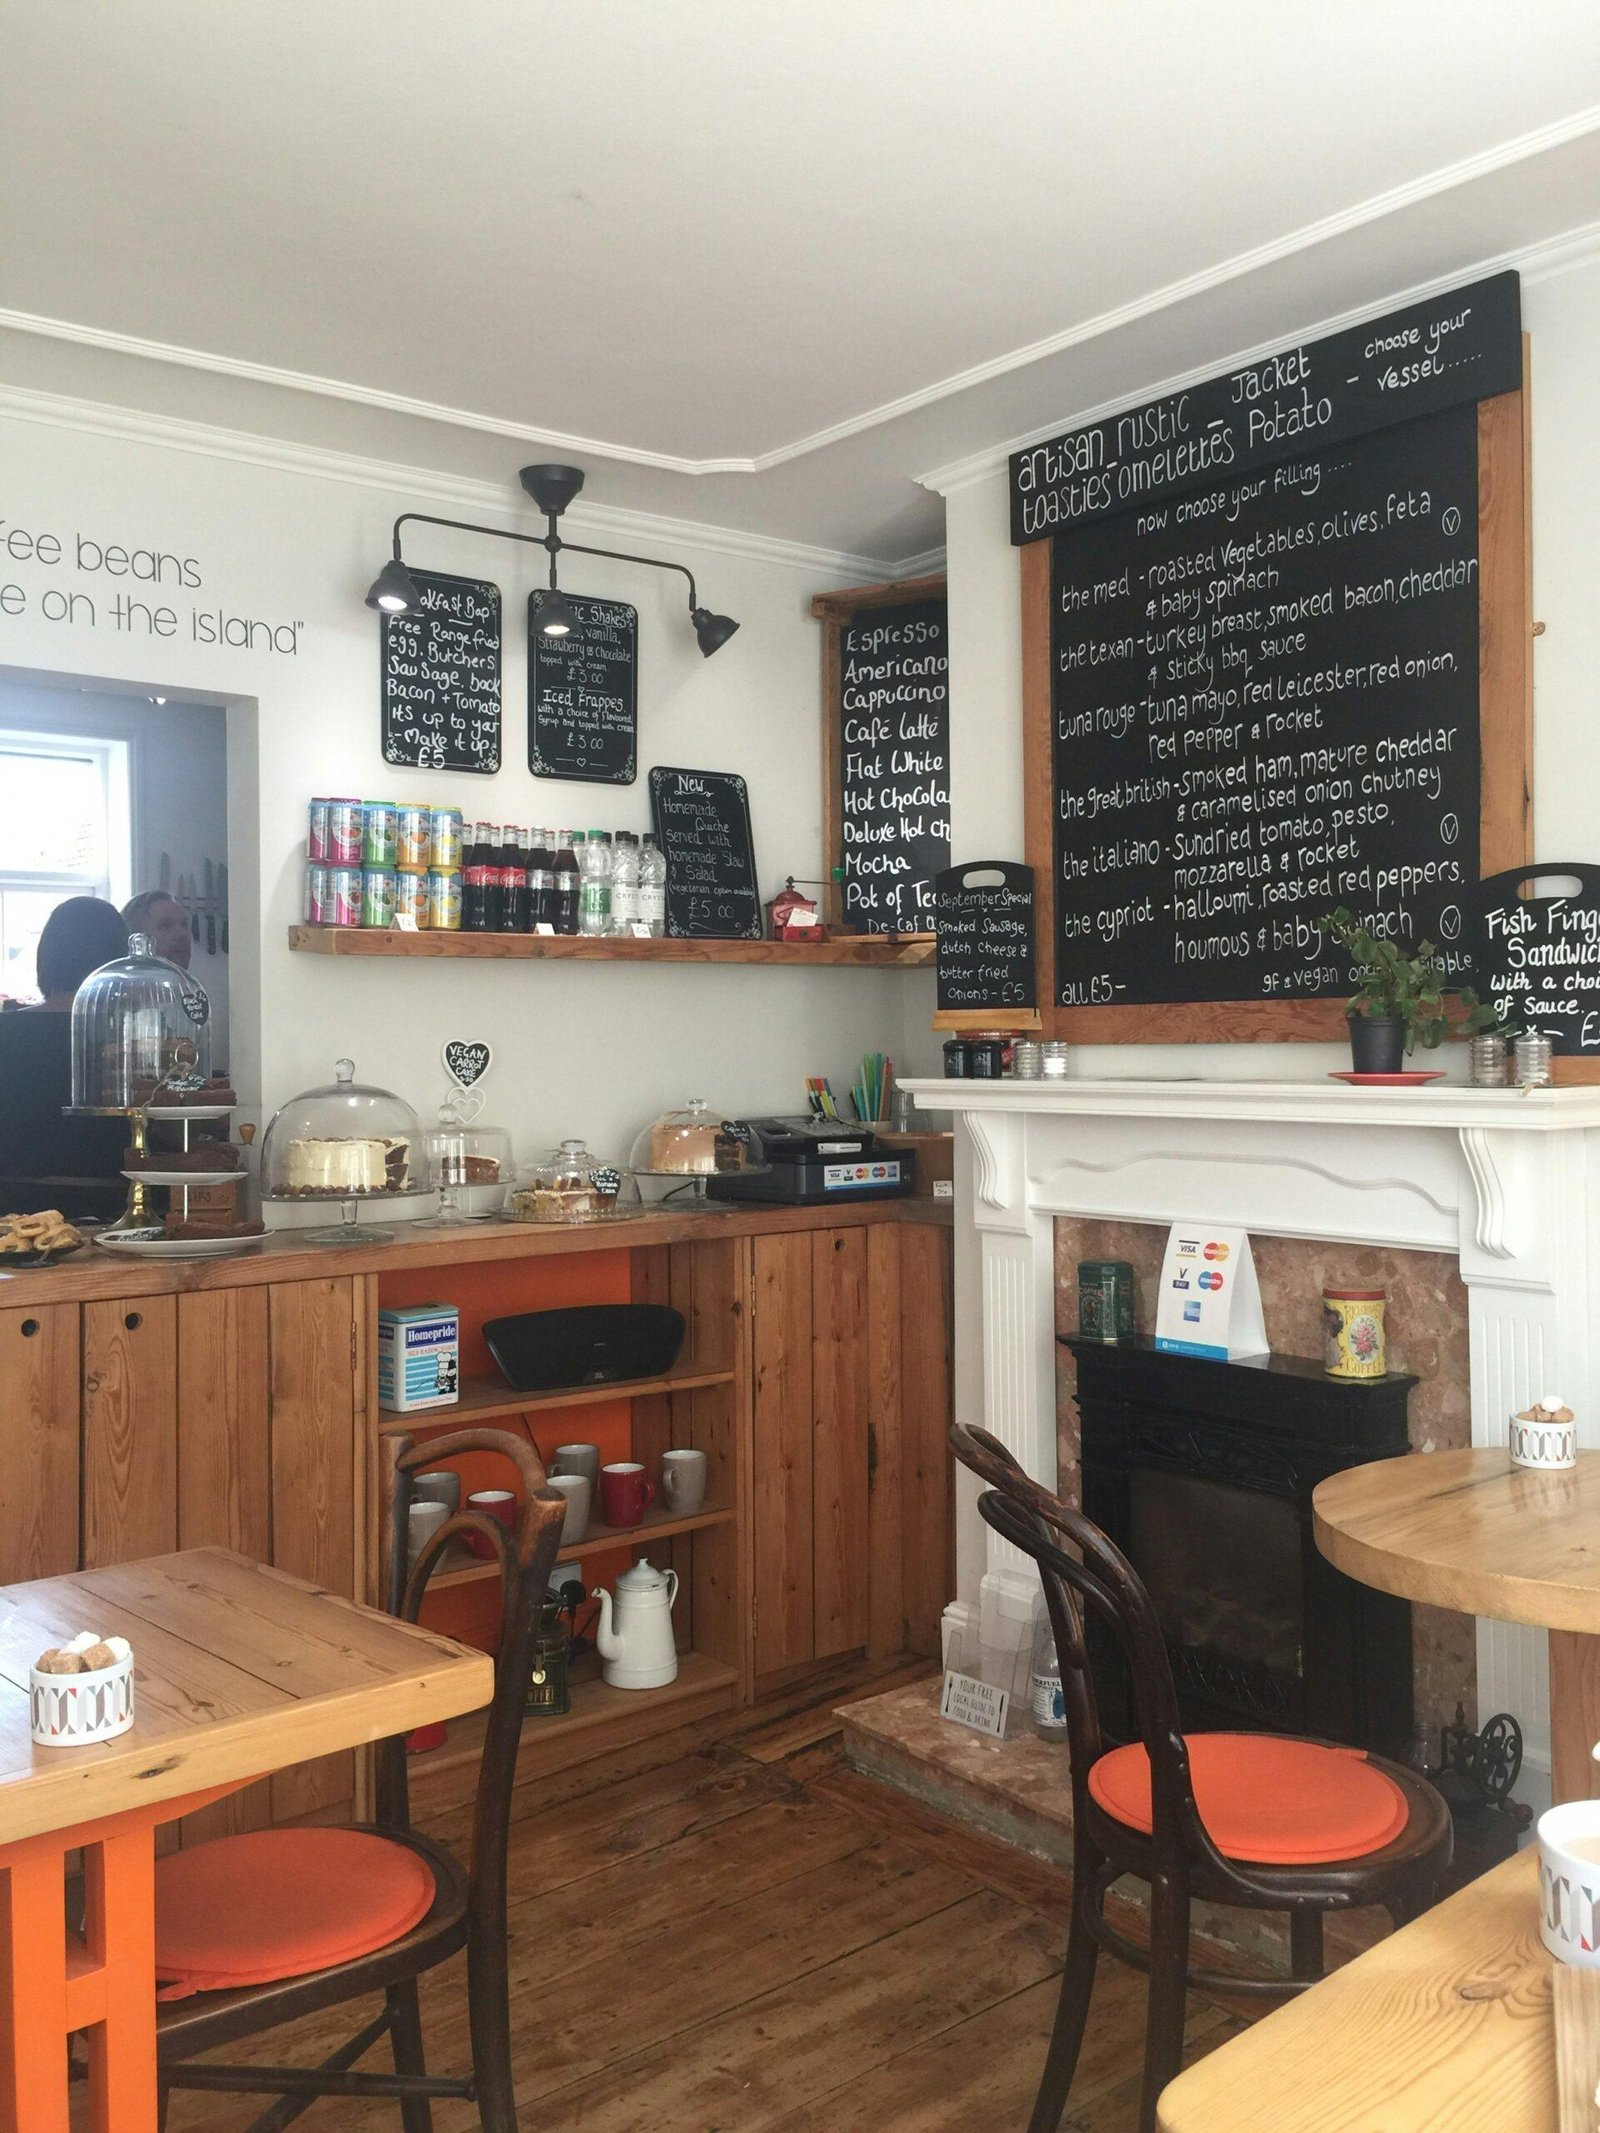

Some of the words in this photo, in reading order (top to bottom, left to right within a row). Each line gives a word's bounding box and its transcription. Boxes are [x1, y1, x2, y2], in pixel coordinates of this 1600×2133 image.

[1018, 428, 1104, 492] artisan
[1117, 395, 1190, 457] rustic
[1231, 347, 1312, 404] Jacket
[1364, 327, 1421, 359] choose
[1424, 308, 1471, 355] your
[1022, 472, 1111, 534] toasties
[1118, 427, 1235, 499] omelettes
[1249, 386, 1332, 449] Potato
[1137, 509, 1168, 537] now
[1176, 491, 1226, 524] choose
[1225, 478, 1266, 523] your
[77, 533, 201, 587] beans
[1062, 585, 1090, 613] the
[1094, 567, 1130, 605] med
[1162, 587, 1201, 621] baby
[1205, 564, 1279, 612] spinach
[42, 591, 95, 626] on
[109, 594, 177, 636] the
[193, 607, 303, 654] island"
[464, 596, 489, 623] Bap
[1060, 641, 1087, 673] the
[1089, 637, 1134, 665] texan
[1266, 587, 1334, 627] smoked
[1399, 558, 1478, 600] cheddar
[389, 615, 421, 635] Free
[430, 622, 471, 651] Range
[472, 629, 499, 650] fried
[846, 621, 940, 655] Espresso
[428, 642, 495, 669] Butchers
[844, 653, 948, 684] Americano
[1221, 642, 1253, 678] bbq
[1258, 632, 1306, 660] sauce
[386, 679, 435, 704] Bacon
[452, 692, 500, 715] Tomato
[470, 672, 501, 698] back
[543, 688, 573, 706] Iced
[843, 678, 946, 714] Cappuccino
[1058, 710, 1093, 740] tuna
[1096, 703, 1135, 738] rouge
[1243, 677, 1272, 704] red
[1369, 655, 1399, 685] red
[423, 713, 443, 729] up
[451, 713, 466, 729] to
[844, 716, 893, 749] Café
[1148, 730, 1176, 764] red
[1183, 722, 1243, 756] pepper
[1266, 702, 1323, 738] rocket
[418, 747, 445, 769] £5
[471, 739, 490, 758] up
[846, 751, 883, 784] Flat
[890, 749, 944, 776] White
[1060, 788, 1085, 820] the
[1087, 781, 1124, 818] great
[1124, 776, 1170, 807] british
[1300, 743, 1368, 777] mature
[1375, 727, 1457, 763] cheddar
[678, 775, 704, 792] New
[1191, 784, 1297, 821] caramelised
[1305, 777, 1353, 803] onion
[1361, 765, 1442, 800] chutney
[663, 797, 718, 818] Homemade
[843, 787, 875, 815] Hot
[843, 820, 897, 844] Deluxe
[900, 815, 925, 843] Hot
[844, 851, 911, 877] Mocha
[1063, 850, 1089, 880] the
[1092, 838, 1160, 874] italiano
[1175, 853, 1272, 890] mozzarella
[1298, 834, 1359, 872] rocket
[846, 881, 879, 910] Pot
[885, 883, 905, 915] of
[938, 891, 1001, 911] September
[1064, 913, 1091, 938] the
[1096, 896, 1154, 943] cypriot
[1262, 870, 1333, 908] roasted
[1338, 864, 1372, 894] red
[1484, 906, 1537, 940] Fish
[1547, 899, 1600, 943] Fing
[941, 941, 971, 955] dutch
[1175, 930, 1250, 964] houmous
[1273, 914, 1321, 961] baby
[940, 965, 973, 980] butter
[978, 964, 1009, 983] fried
[1563, 971, 1600, 991] choi
[1002, 981, 1025, 1002] £5
[1061, 982, 1089, 1005] all
[1493, 994, 1515, 1021] of
[449, 1045, 487, 1060] VEGAN
[449, 1056, 484, 1069] CARROT
[455, 1067, 476, 1077] CAKE
[1180, 1245, 1196, 1253] VISA
[408, 1325, 455, 1342] Homepride
[960, 1680, 976, 1694] YOUR
[977, 1685, 993, 1701] FREE
